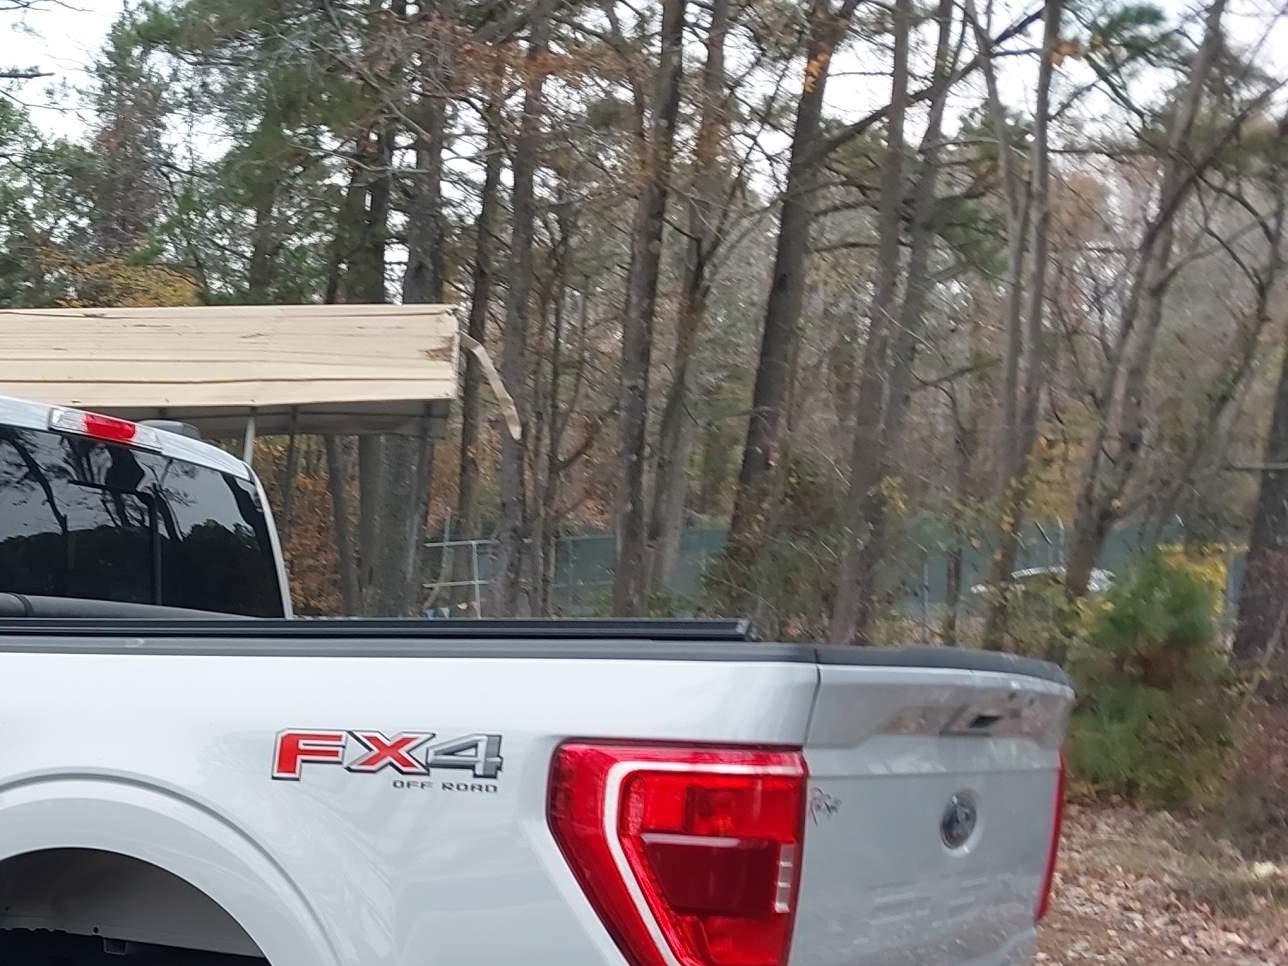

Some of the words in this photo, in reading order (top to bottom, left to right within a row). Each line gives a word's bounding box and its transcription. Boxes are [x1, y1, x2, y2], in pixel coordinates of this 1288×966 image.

[272, 728, 503, 781] FX4
[392, 780, 433, 790] OFF
[441, 782, 498, 793] ROAD
